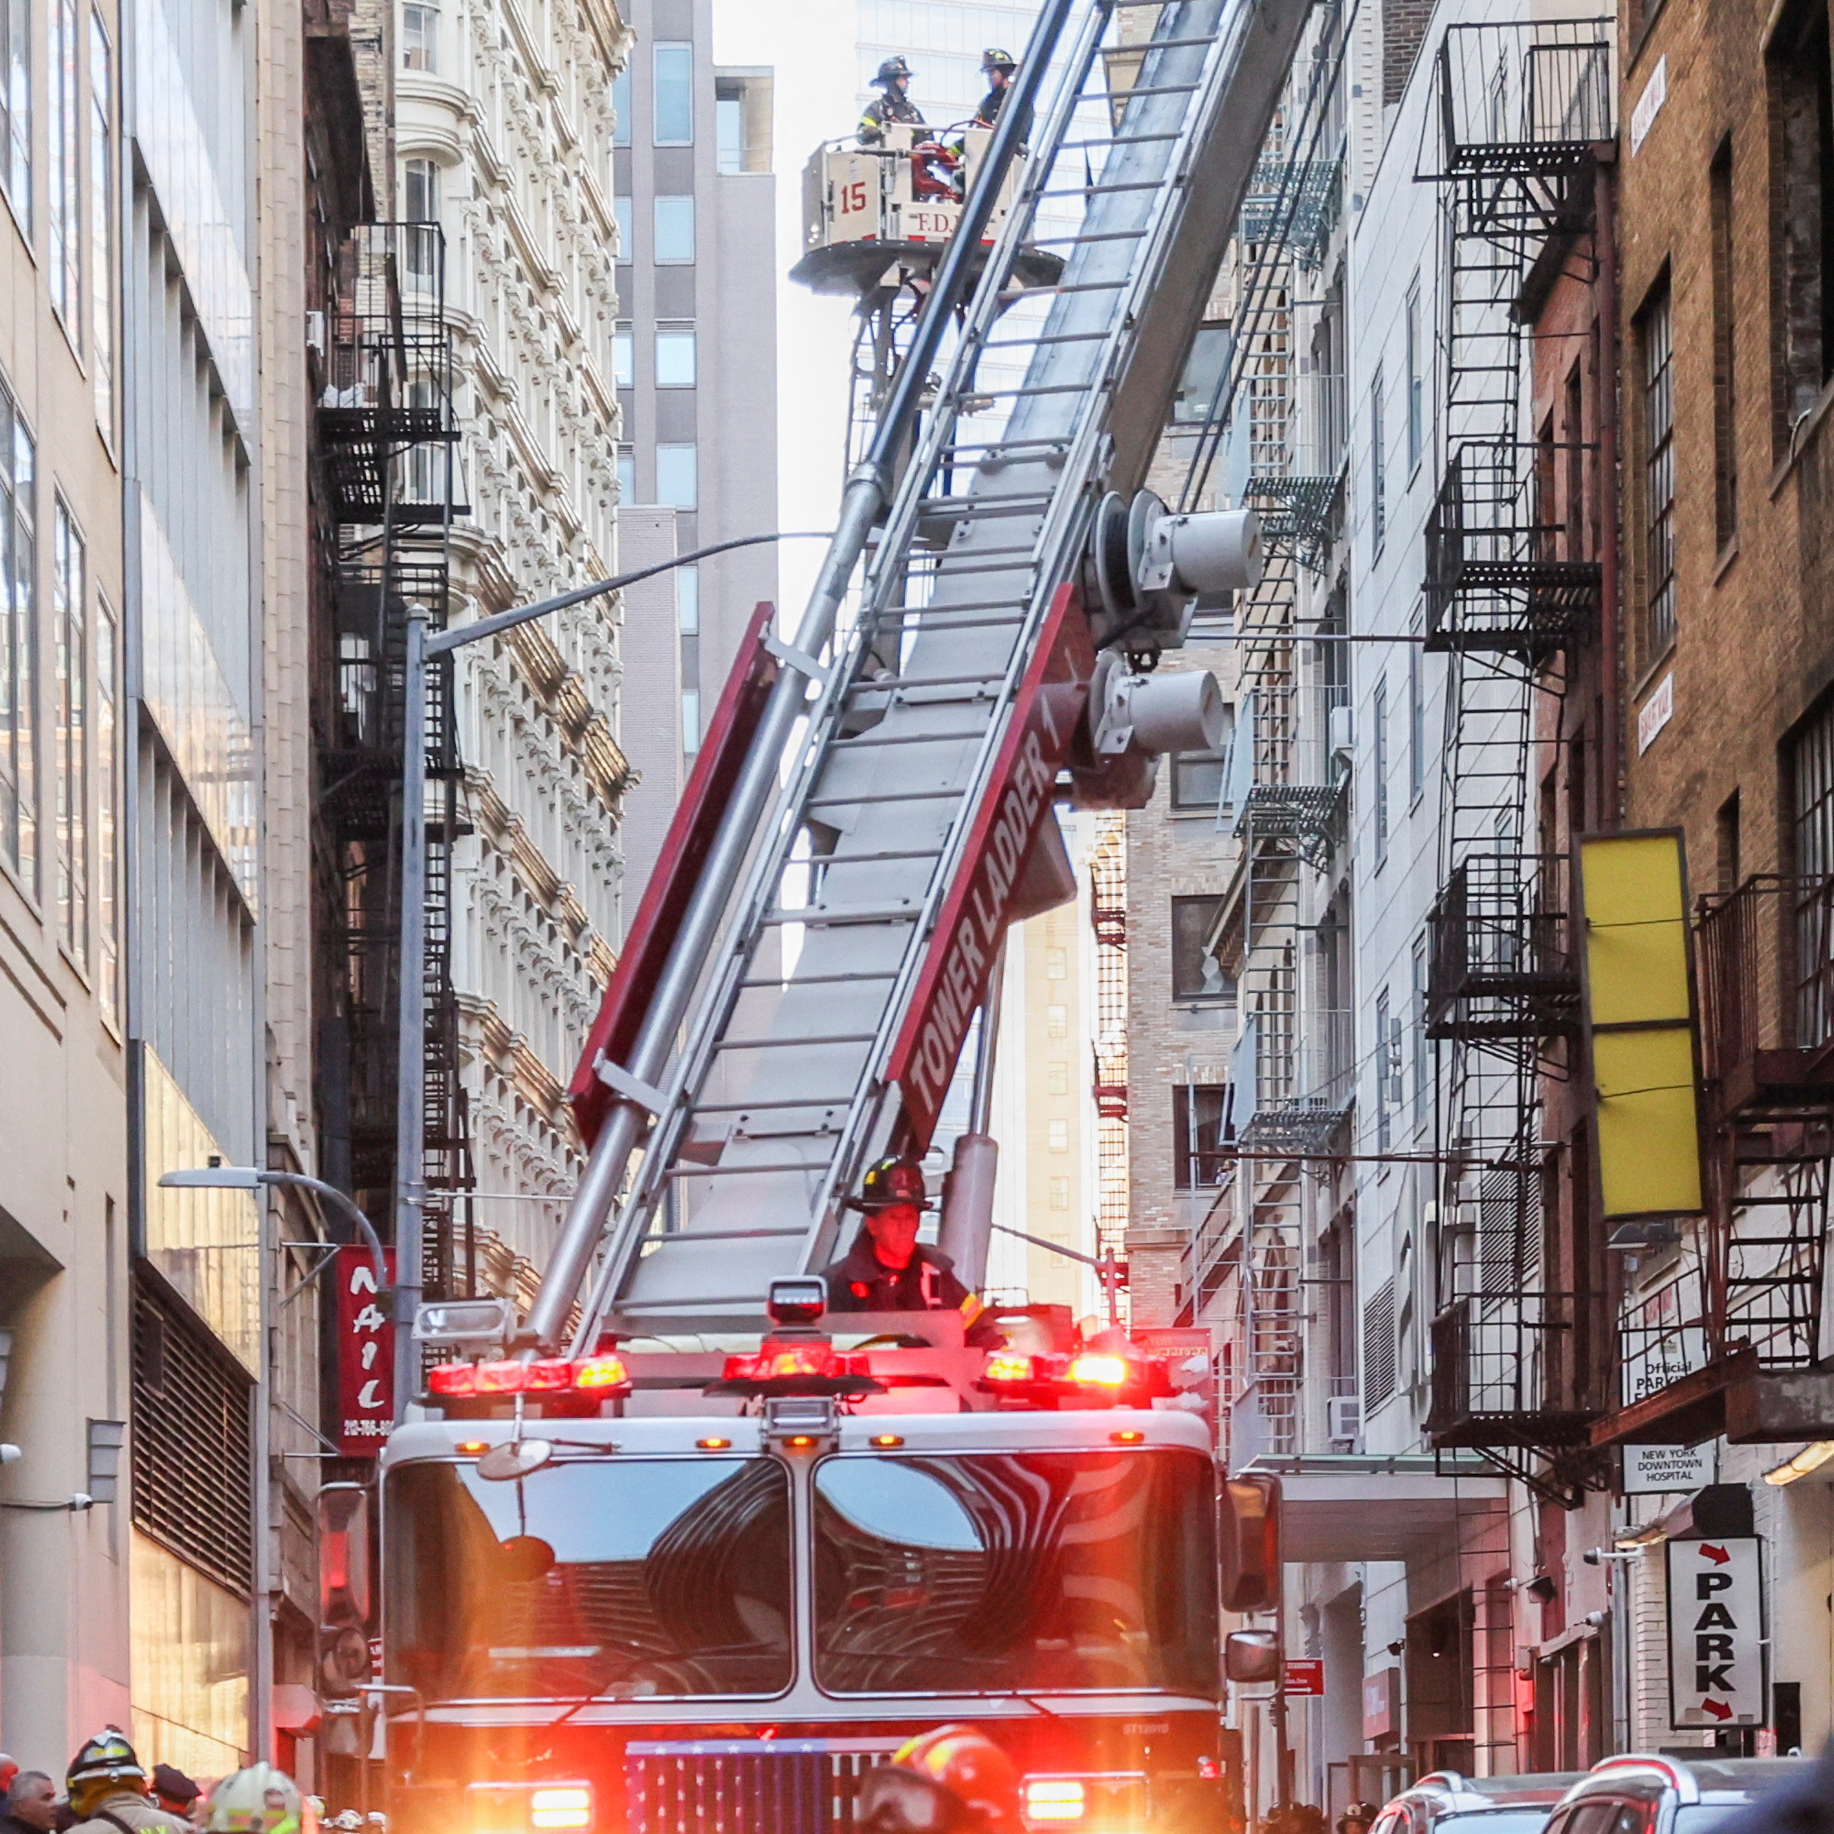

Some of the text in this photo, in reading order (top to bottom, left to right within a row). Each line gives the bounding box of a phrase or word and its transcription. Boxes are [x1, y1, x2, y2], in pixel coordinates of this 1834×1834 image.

[841, 181, 867, 214] 15
[908, 691, 1061, 1115] TOWER LADDER 1
[1646, 1360, 1692, 1376] Official
[1642, 1449, 1697, 1461] NEW YORK
[1638, 1459, 1703, 1472] DOWNTOWN
[1646, 1471, 1693, 1482] HOSPITAL
[1694, 1572, 1738, 1692] PARK
